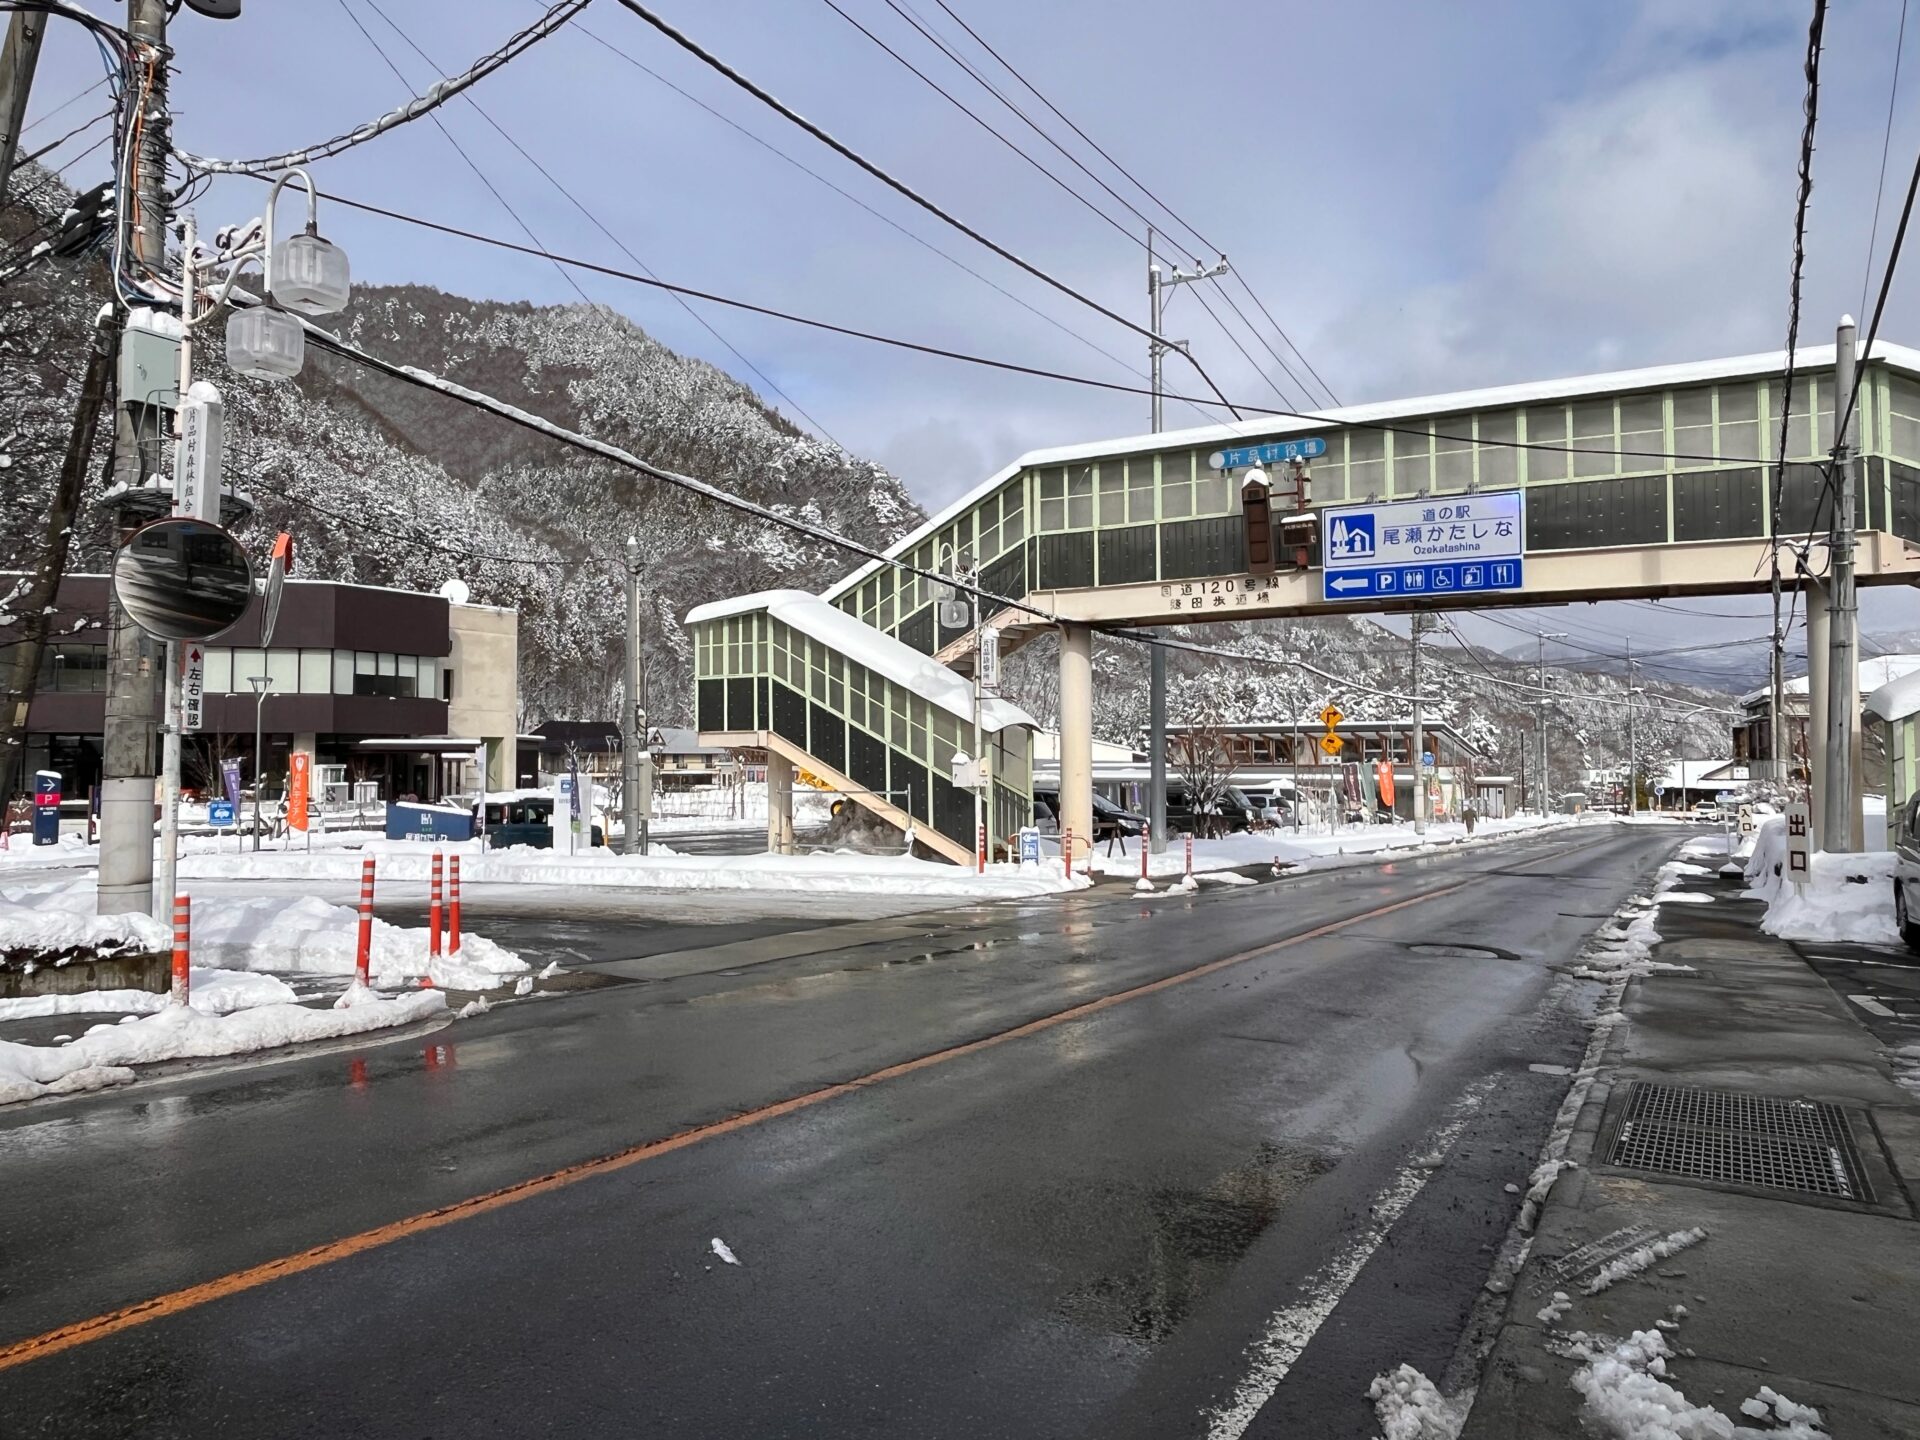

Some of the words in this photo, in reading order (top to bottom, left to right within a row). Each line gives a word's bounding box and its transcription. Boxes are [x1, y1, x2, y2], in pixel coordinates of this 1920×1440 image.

[1422, 504, 1471, 522] 道の駅
[1383, 520, 1513, 545] 尾瀬かたしな
[1413, 542, 1481, 555] Ozekatashina
[187, 666, 201, 726] 左右確認
[1741, 809, 1752, 831] 入口
[1789, 814, 1806, 872] 出口
